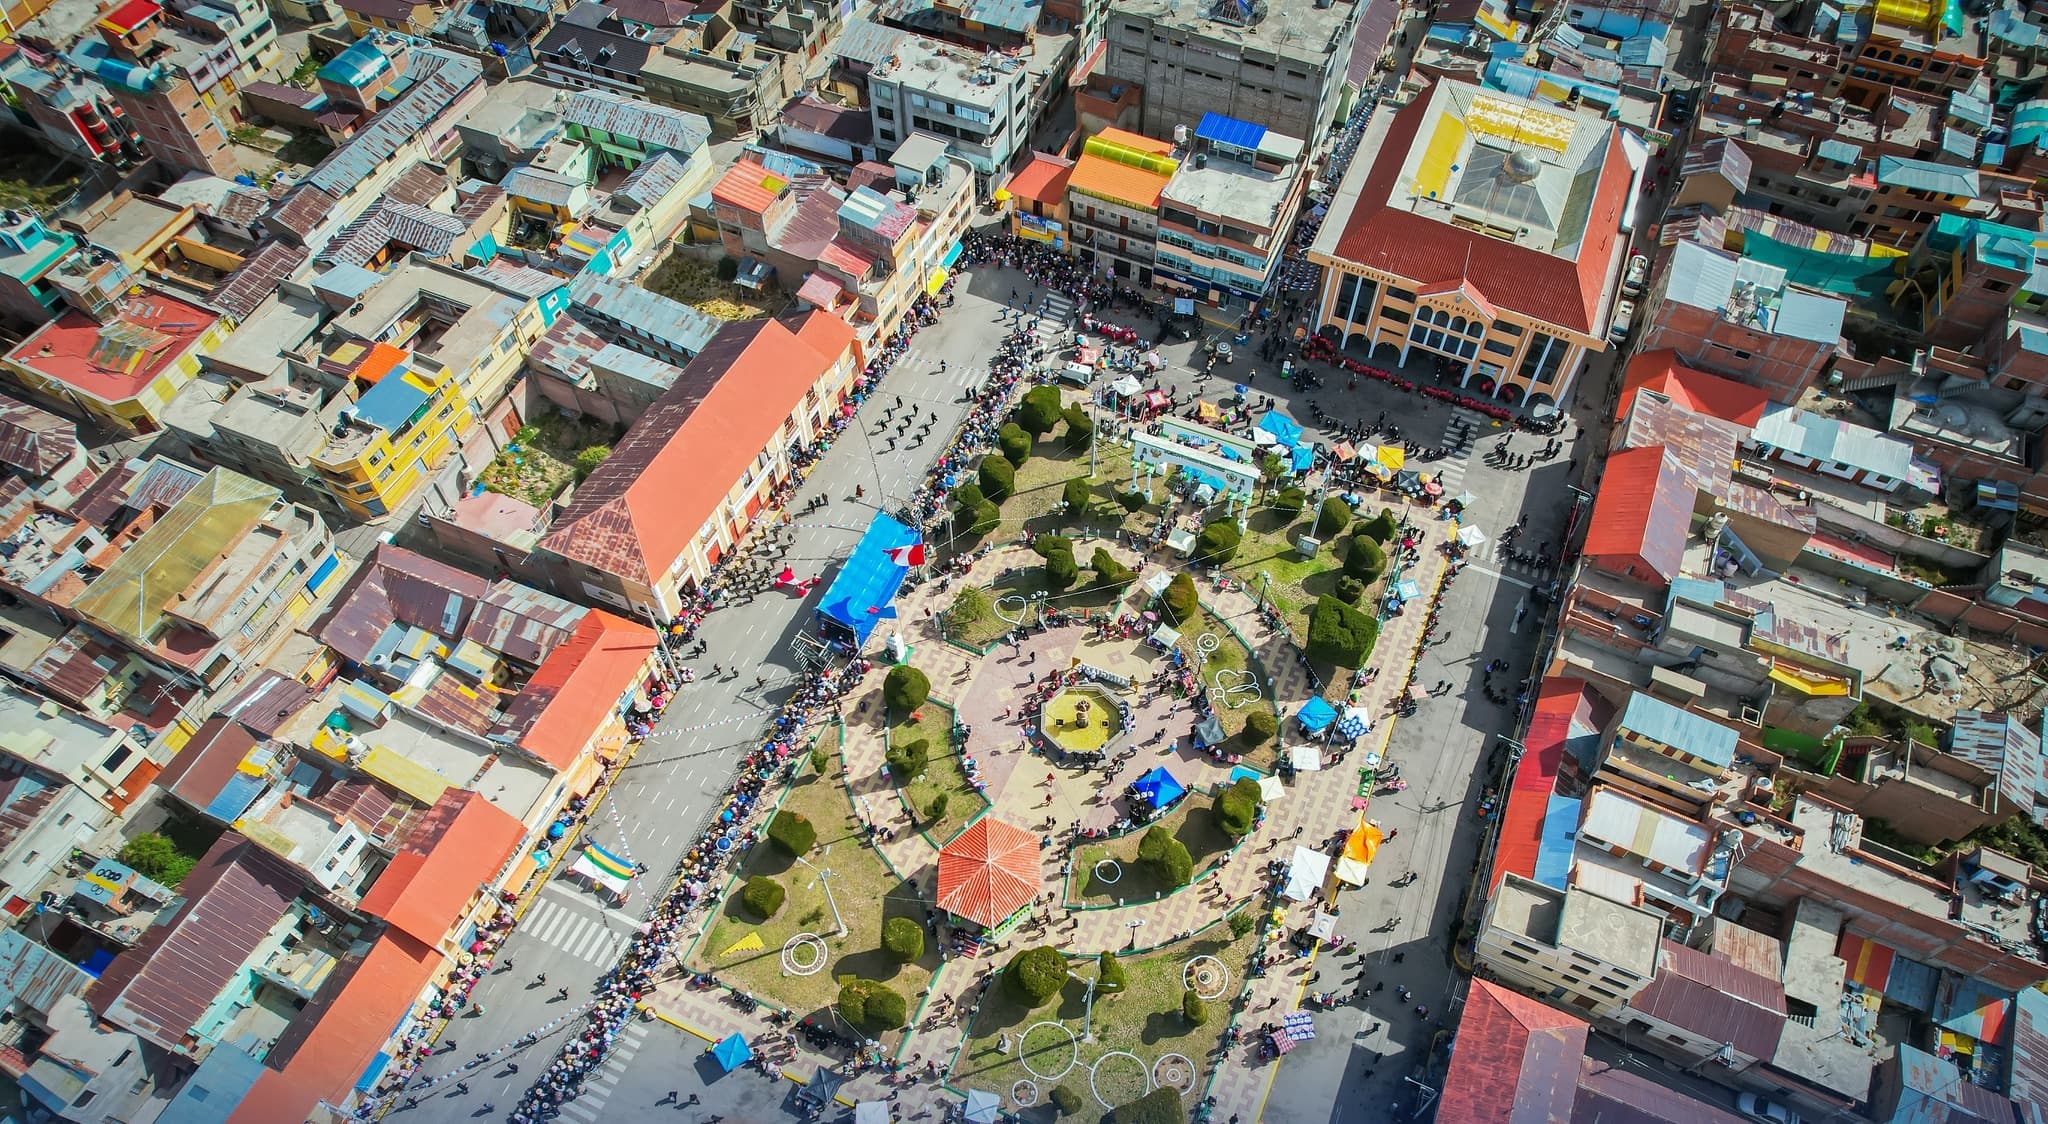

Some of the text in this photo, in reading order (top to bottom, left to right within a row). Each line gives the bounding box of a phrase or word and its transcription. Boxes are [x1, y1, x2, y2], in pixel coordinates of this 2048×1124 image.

[1330, 261, 1396, 284] MUNICIPALIDAD
[1428, 298, 1480, 318] PROVINCIAL
[1529, 322, 1570, 338] YUNGUYO
